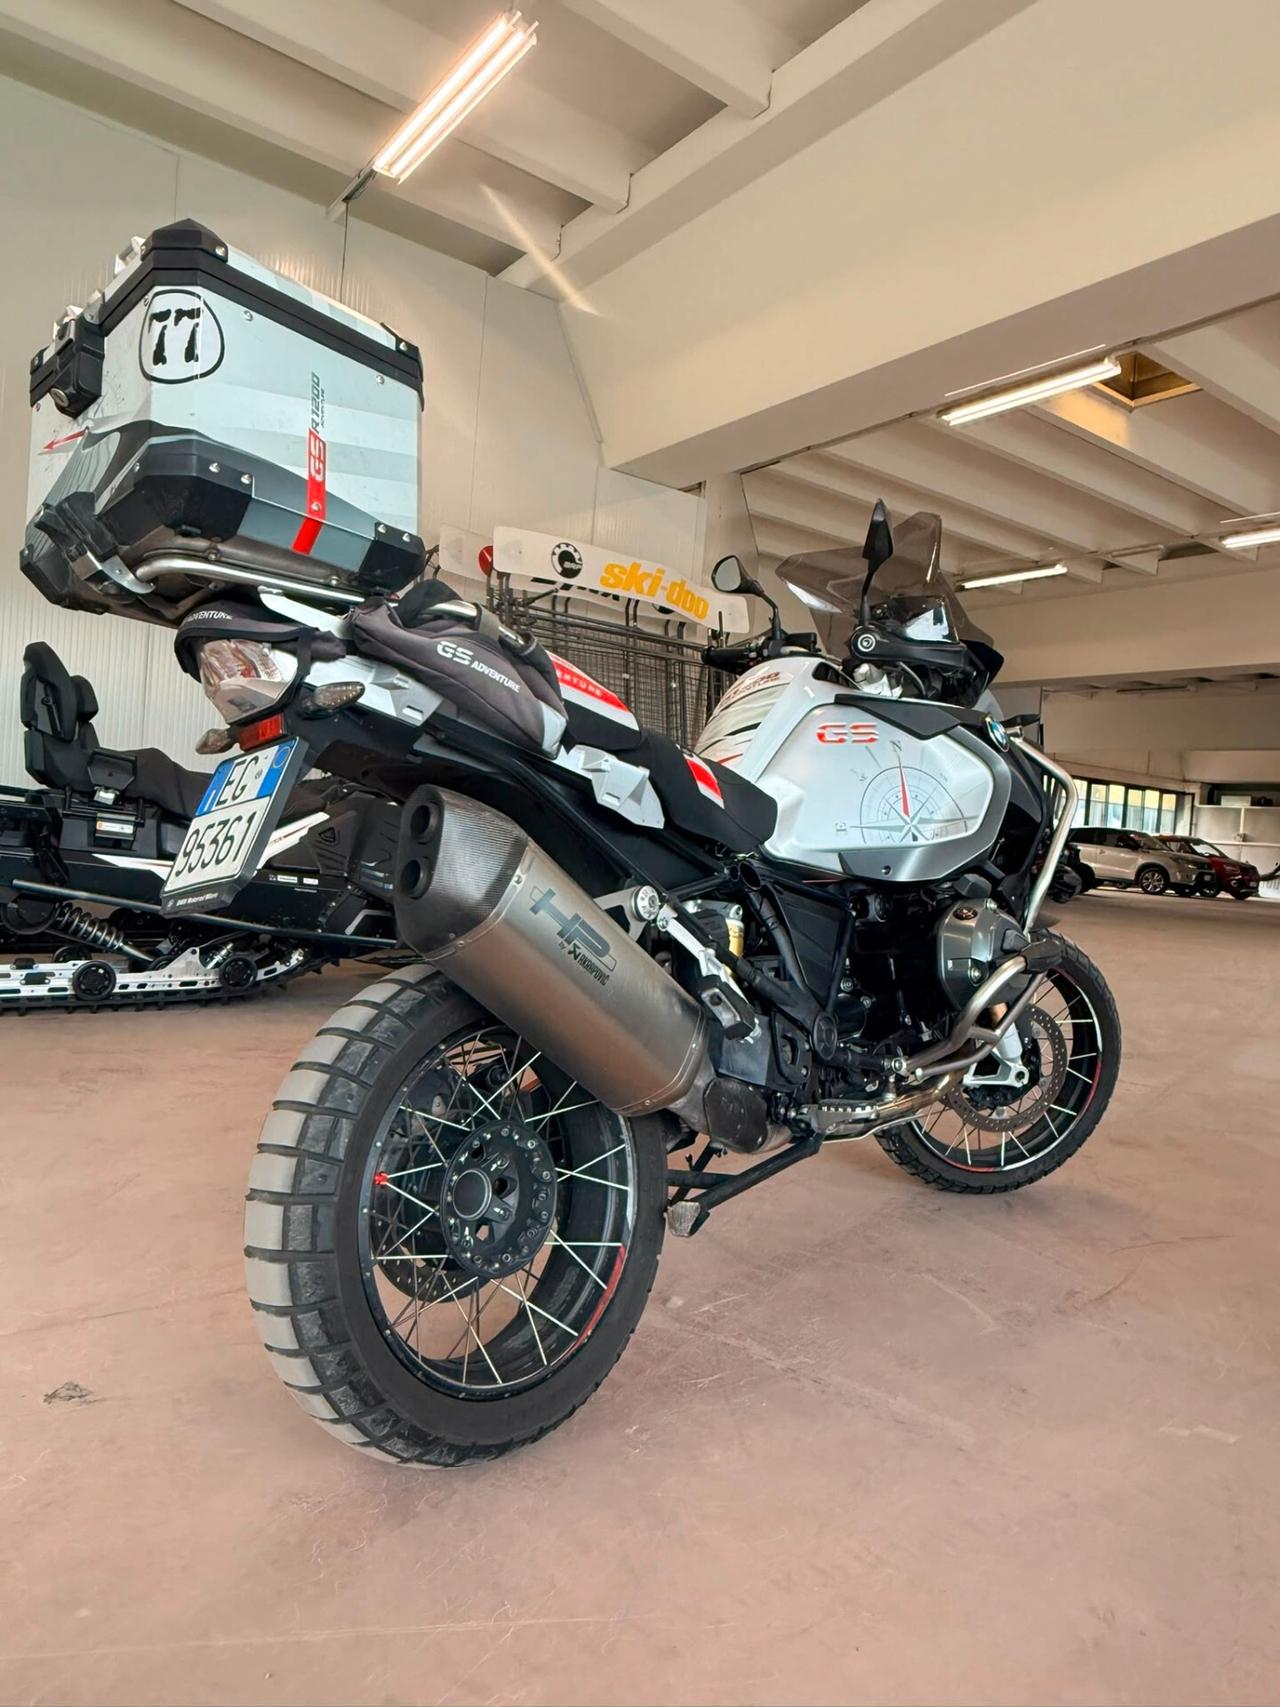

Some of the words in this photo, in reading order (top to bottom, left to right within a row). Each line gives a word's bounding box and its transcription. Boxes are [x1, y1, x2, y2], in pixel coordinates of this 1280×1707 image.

[148, 307, 202, 366] 77
[599, 561, 710, 621] ski-doo
[437, 641, 474, 665] GS
[470, 661, 521, 693] ADVENTURE
[815, 722, 879, 745] GS
[216, 754, 260, 806] EG
[174, 811, 257, 878] 95361
